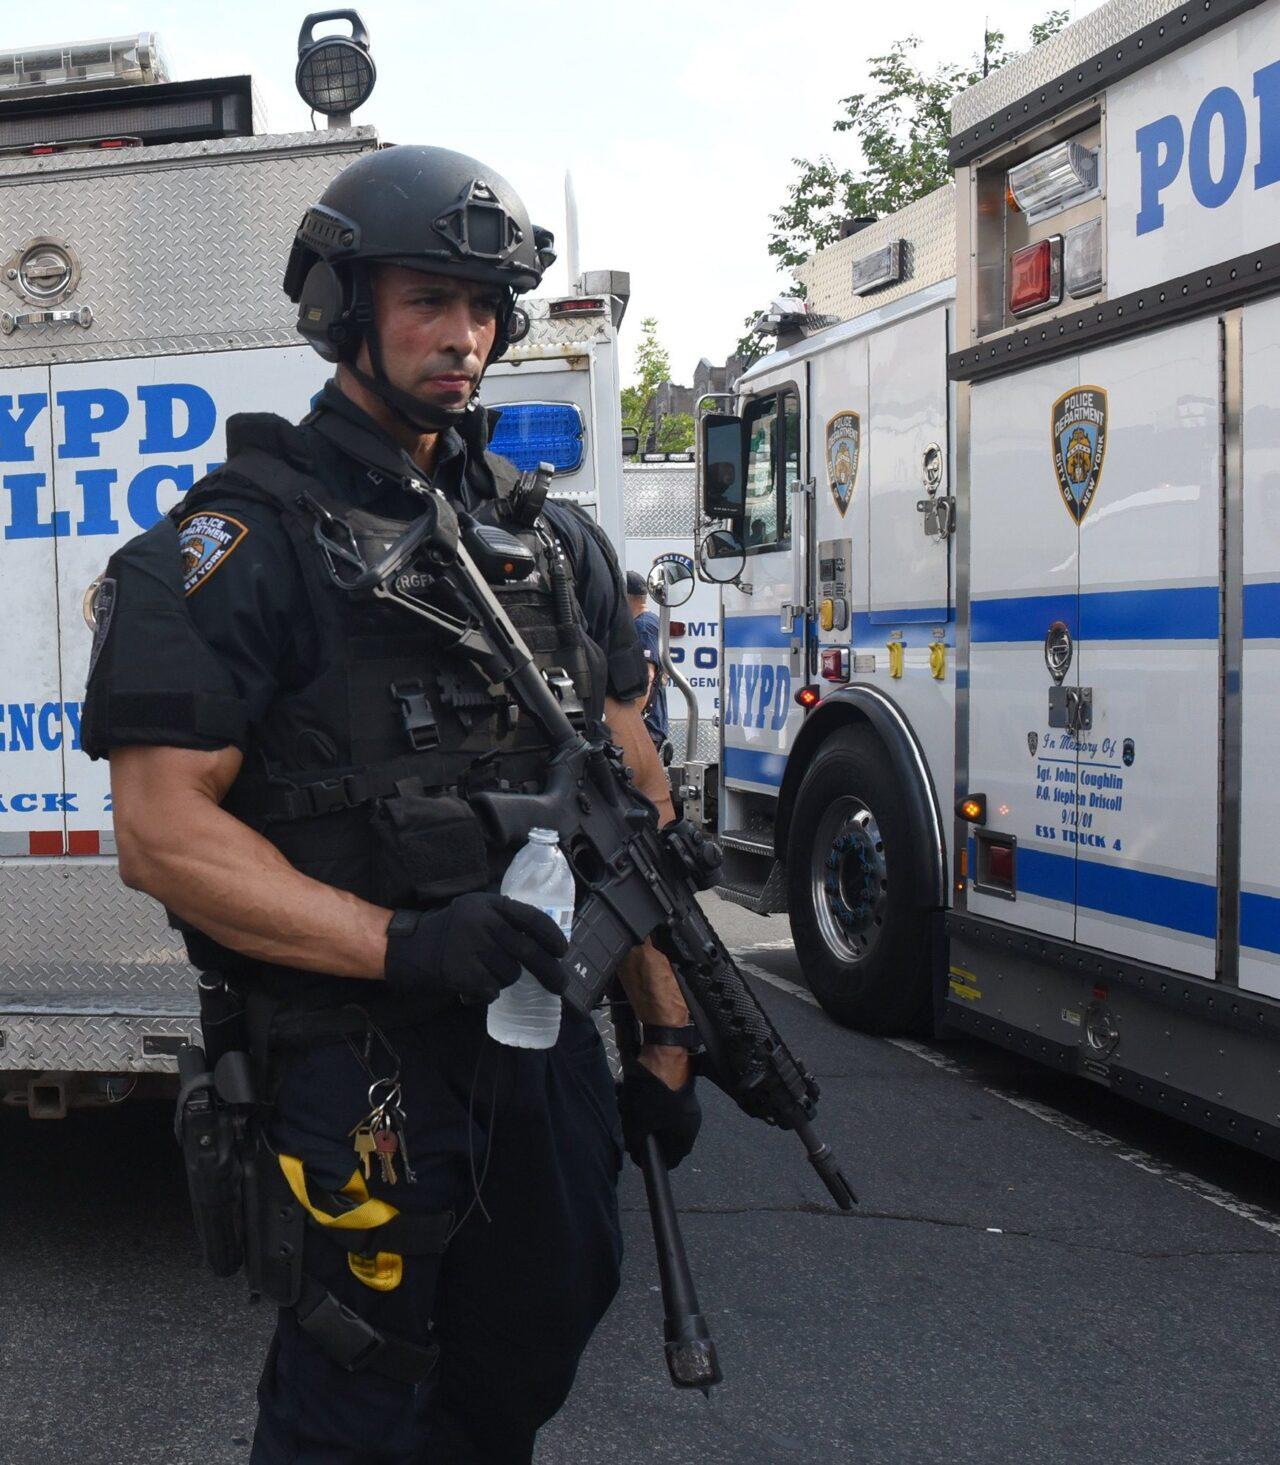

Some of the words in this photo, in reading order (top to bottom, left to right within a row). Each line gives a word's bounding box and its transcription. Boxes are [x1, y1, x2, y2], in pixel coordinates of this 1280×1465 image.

[1064, 392, 1095, 414] POLICE
[1054, 407, 1105, 439] DEPARTMENT
[1055, 452, 1067, 483] CITY
[1063, 486, 1074, 502] OF
[1083, 477, 1096, 507] NEW
[1093, 434, 1105, 472] YORK
[179, 524, 232, 545] PARTMENT
[190, 516, 226, 530] POLICE
[183, 574, 199, 591] EW
[197, 548, 226, 576] YORK
[724, 663, 791, 731] NYPD
[1042, 733, 1056, 749] In
[1059, 734, 1098, 760] Memory
[1101, 737, 1117, 759] Of
[1036, 764, 1052, 783] Sgt.
[1055, 767, 1076, 784] John
[1080, 769, 1123, 790] Coughlin
[1036, 785, 1051, 801] P.O.
[1053, 787, 1086, 806] Stephen
[1089, 792, 1123, 812] Driscoll
[1035, 824, 1056, 840] ESS
[1061, 829, 1106, 849] TRUCK
[1113, 838, 1122, 852] 4
